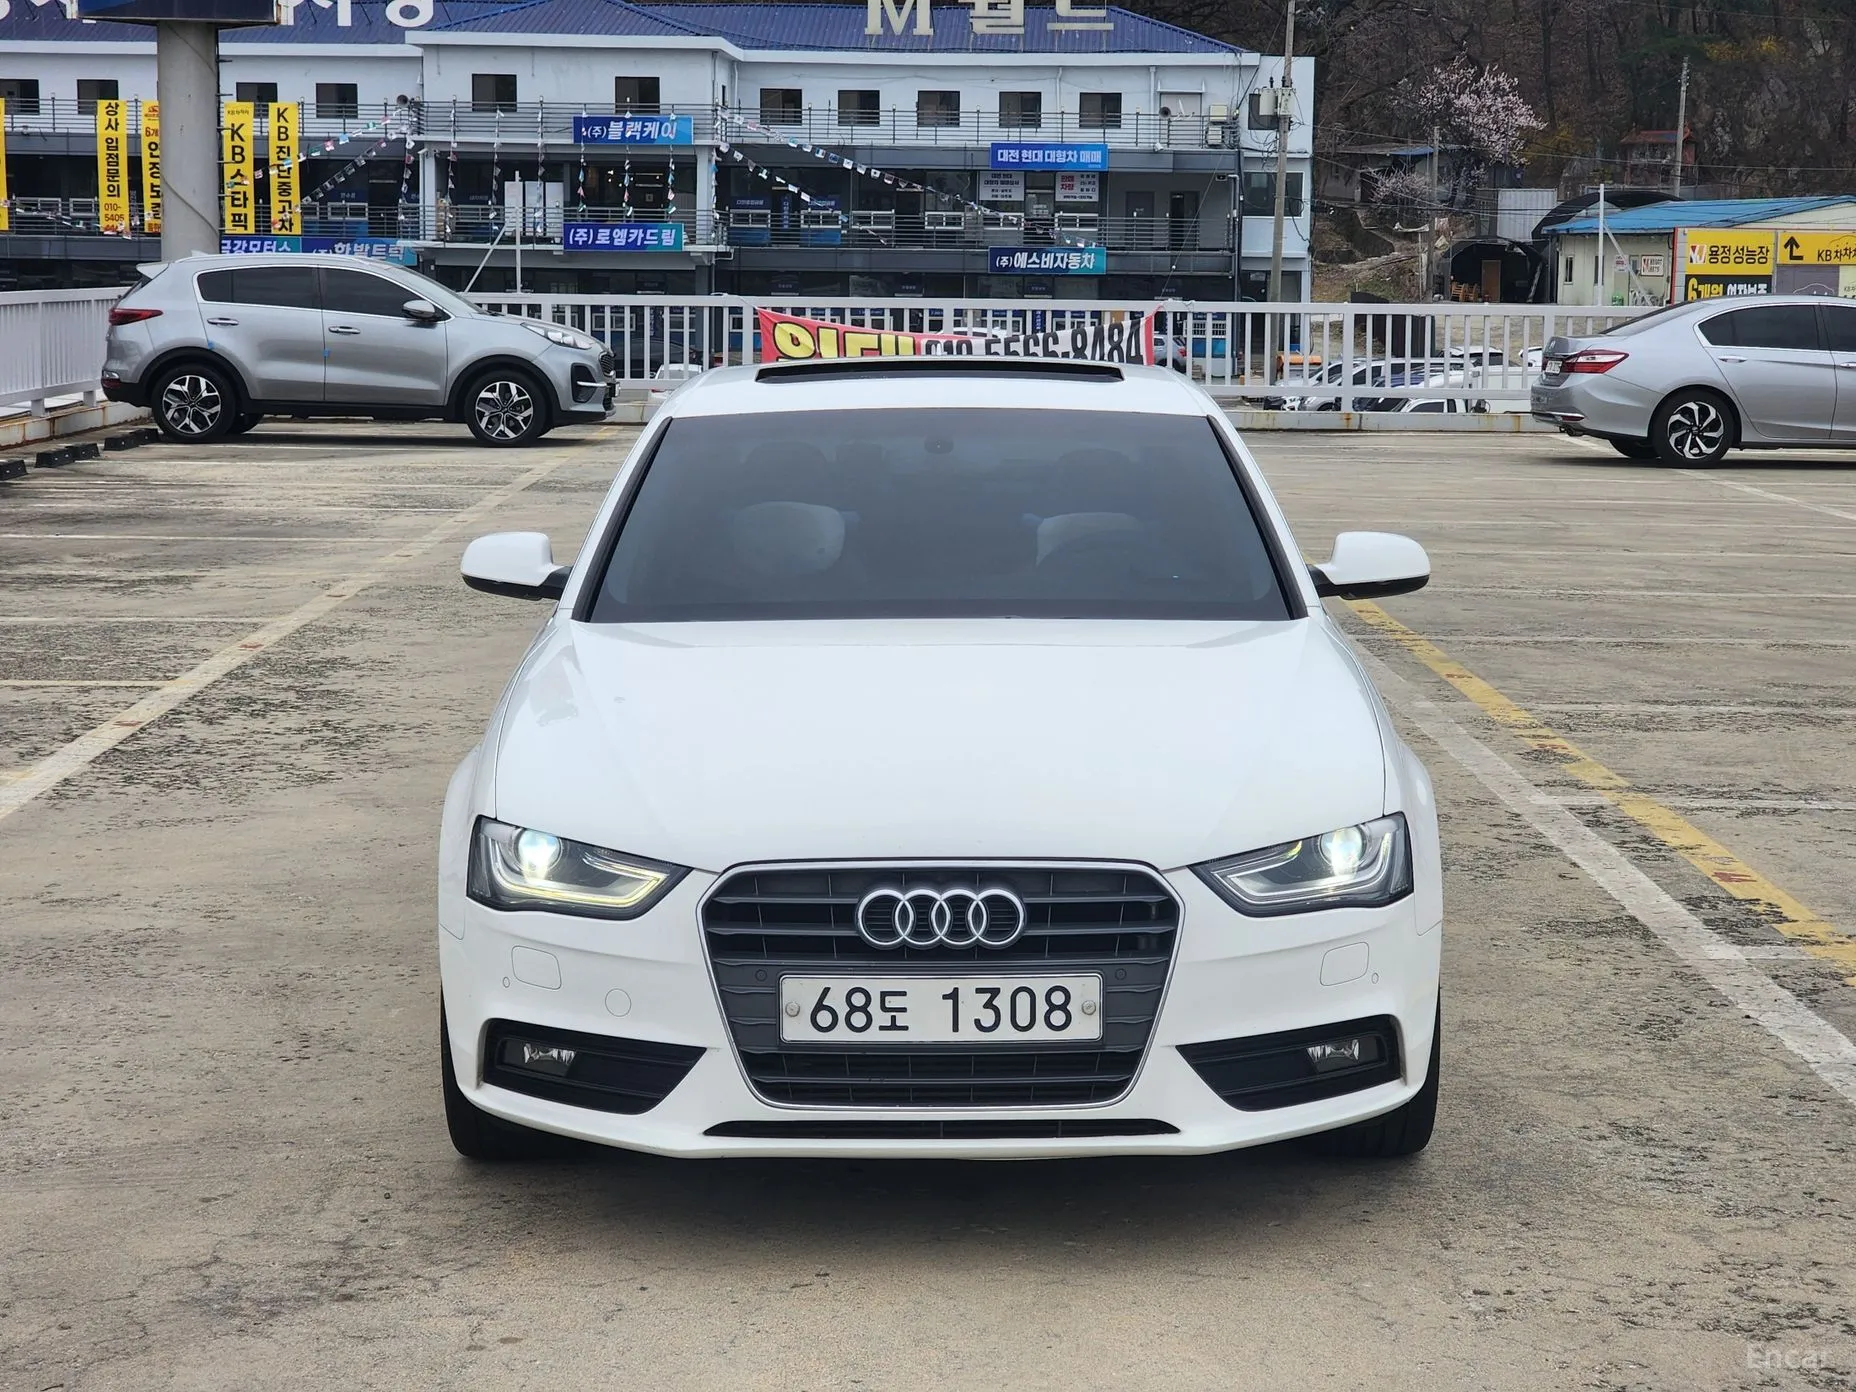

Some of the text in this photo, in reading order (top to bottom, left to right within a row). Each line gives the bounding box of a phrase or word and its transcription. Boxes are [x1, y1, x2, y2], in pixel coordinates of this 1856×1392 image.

[997, 149, 1020, 163] 대전
[1021, 149, 1044, 163] 현대
[1044, 149, 1078, 163] 대형차
[1708, 245, 1731, 265] 용정
[810, 984, 1073, 1033] 68도 1308
